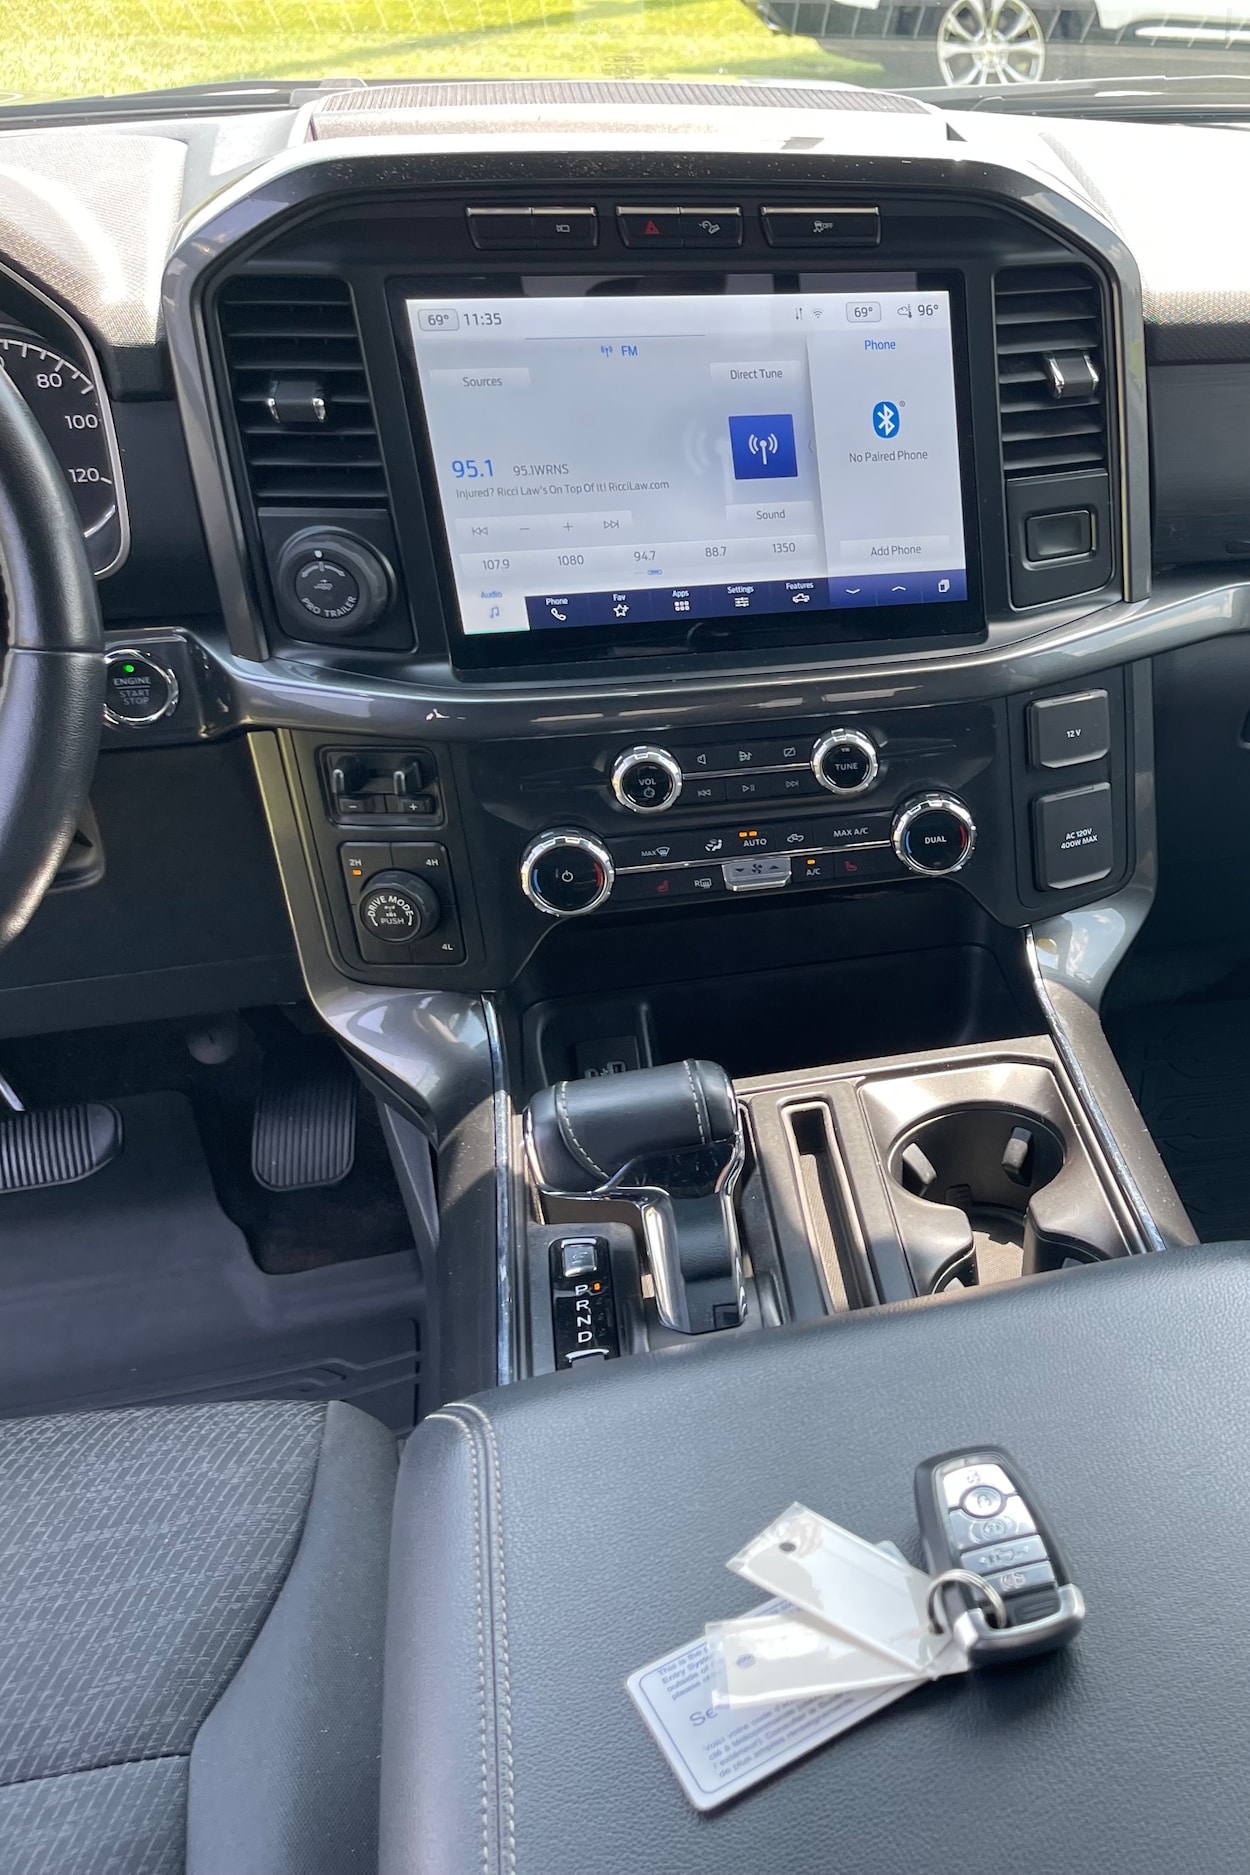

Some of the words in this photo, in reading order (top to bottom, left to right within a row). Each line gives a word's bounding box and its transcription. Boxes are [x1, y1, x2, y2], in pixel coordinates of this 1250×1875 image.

[853, 306, 874, 318] 69°
[917, 304, 939, 316] 96°
[427, 314, 450, 326] 69°
[463, 312, 502, 326] 11:35
[621, 345, 639, 357] FM
[864, 339, 896, 351] Phone
[730, 369, 758, 380] Direct
[759, 368, 783, 379] Tune
[36, 373, 63, 389] 80
[462, 376, 503, 388] Sources
[64, 413, 98, 429] 100
[849, 452, 863, 463] No
[865, 451, 896, 462] Paired
[897, 450, 928, 461] Phone
[451, 459, 495, 478] 95.1
[512, 463, 569, 477] 95.1WRNS
[68, 467, 100, 483] 120
[456, 488, 495, 500] Injured?
[497, 486, 519, 497] Ricci
[520, 485, 548, 496] Law's
[549, 484, 563, 495] On
[564, 484, 582, 496] Top
[583, 482, 595, 494] Of
[608, 480, 670, 492] RicciLaw.com
[756, 509, 786, 521] Sound
[705, 546, 727, 558] 88.7
[772, 542, 796, 554] 1350
[870, 545, 890, 557] Add
[891, 544, 922, 556] Phone
[557, 554, 584, 567] 1080
[633, 550, 656, 562] 94.7
[482, 558, 510, 571] 107.9
[727, 585, 755, 595] Settings
[785, 581, 814, 591] Features
[480, 591, 503, 600] Audio
[612, 593, 626, 603] Fav
[672, 588, 690, 599] Apps
[301, 597, 321, 615] PRO
[324, 595, 357, 618] TRAILER
[545, 597, 569, 606] Phone
[113, 676, 152, 687] ENGINE
[119, 689, 150, 698] START
[123, 697, 150, 706] STOP
[1066, 729, 1076, 739] 12
[1075, 728, 1082, 738] V
[834, 762, 859, 771] TUNE
[638, 778, 657, 786] VOL
[833, 829, 852, 838] MAX
[853, 827, 869, 836] A/C
[1065, 831, 1076, 841] AC
[1076, 827, 1093, 839] 120V
[743, 838, 768, 848] AUTO
[924, 835, 947, 845] DUAL
[1060, 838, 1082, 850] 400W
[1082, 834, 1098, 846] MAX
[640, 849, 657, 857] MAX
[349, 858, 362, 867] 2H
[425, 858, 439, 867] 4H
[806, 867, 821, 877] A/C
[367, 895, 388, 918] DRIVE
[388, 895, 415, 918] MODE
[380, 917, 405, 925] PUSH
[441, 943, 454, 951] 4L
[575, 1284, 589, 1296] P
[575, 1299, 591, 1313] R
[576, 1314, 592, 1327] N
[577, 1331, 593, 1344] D
